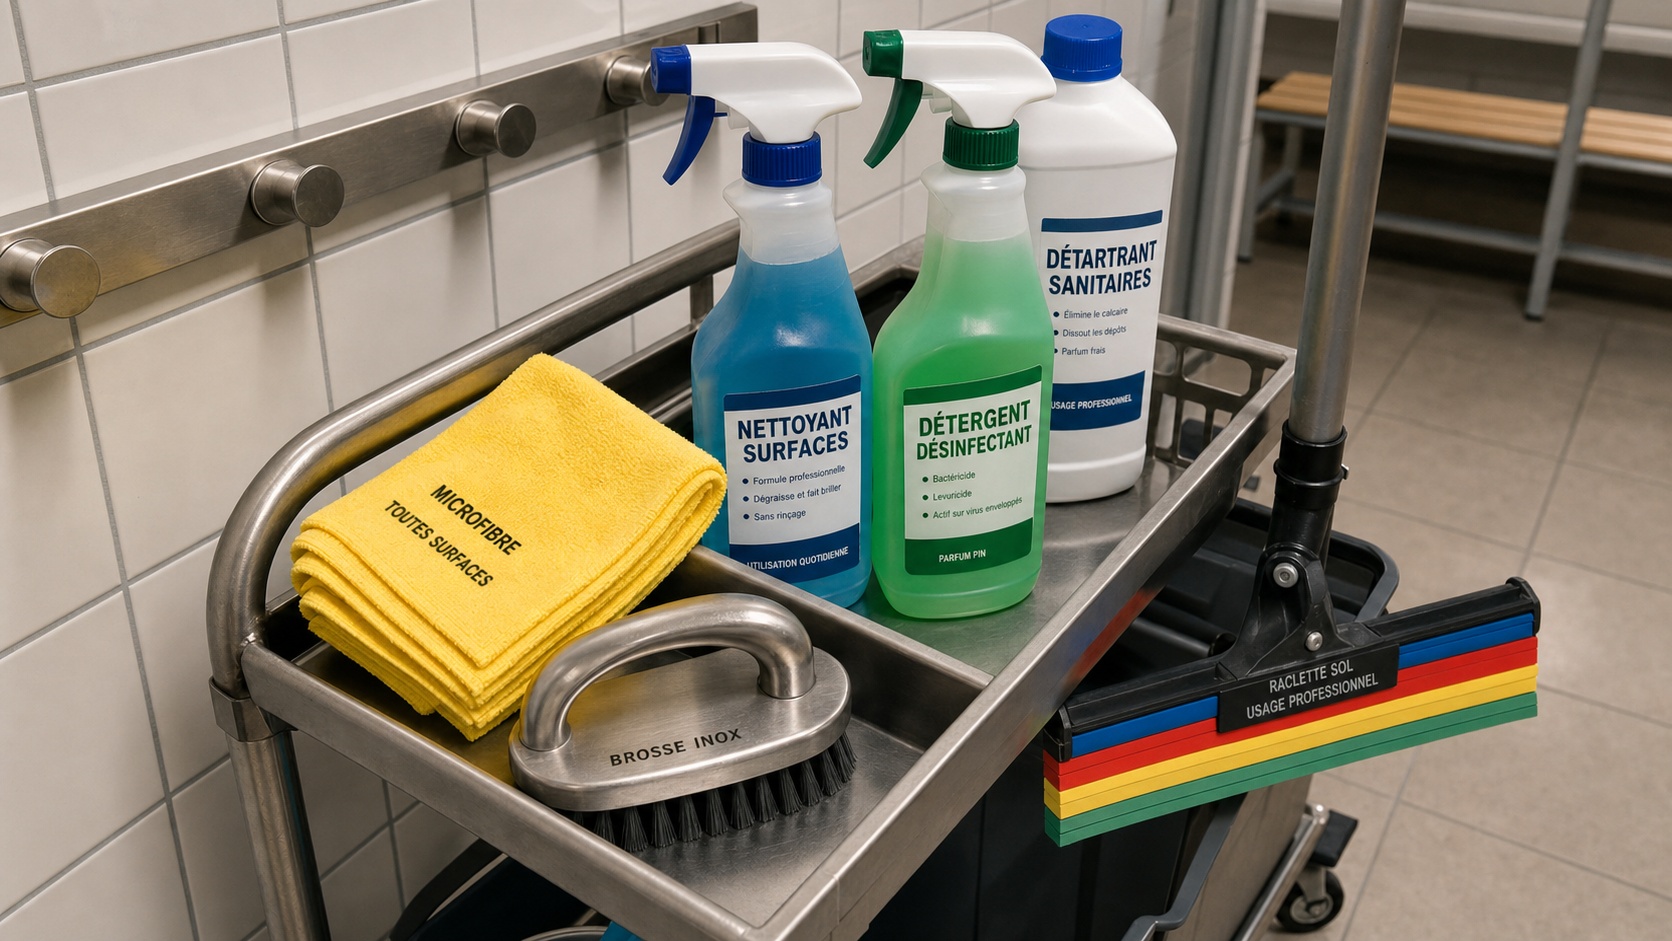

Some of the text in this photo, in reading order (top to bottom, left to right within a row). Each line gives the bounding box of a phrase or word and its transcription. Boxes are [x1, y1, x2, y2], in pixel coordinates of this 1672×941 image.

[1047, 240, 1157, 269] DÉTARTRANT
[1049, 268, 1151, 295] SANITAIRES
[1064, 309, 1091, 318] Élimine
[1102, 307, 1128, 317] calcaire
[1063, 326, 1126, 337] Dissout les dépôts
[1091, 347, 1105, 355] frais
[1077, 394, 1132, 409] PROFESSIONNEL
[738, 405, 851, 439] NETTOYANT
[920, 400, 1030, 437] DÉTERGENT
[743, 431, 848, 463] SURFACES
[917, 425, 1032, 460] DÉSINFECTANT
[753, 465, 845, 485] Formule professionnelle
[933, 472, 976, 483] Bactéricide
[754, 493, 795, 504] Dégraisse
[807, 488, 819, 497] fait
[821, 484, 841, 494] briller
[933, 490, 972, 501] Levuricide
[754, 509, 806, 521] Sans rinçage
[933, 510, 950, 519] Actif
[966, 507, 983, 516] virus
[986, 497, 1022, 513] enveloppés
[430, 484, 522, 555] MICROFIBRE
[385, 500, 494, 586] TOUTES SURFACES
[799, 546, 848, 566] QUOTIDIENNE
[939, 549, 986, 562] PARFUM PIN
[1270, 660, 1354, 693] RACLETTE SOL
[1247, 673, 1378, 719] USAGE PROFESSIONNEL
[610, 729, 742, 766] BROSSE INOX
